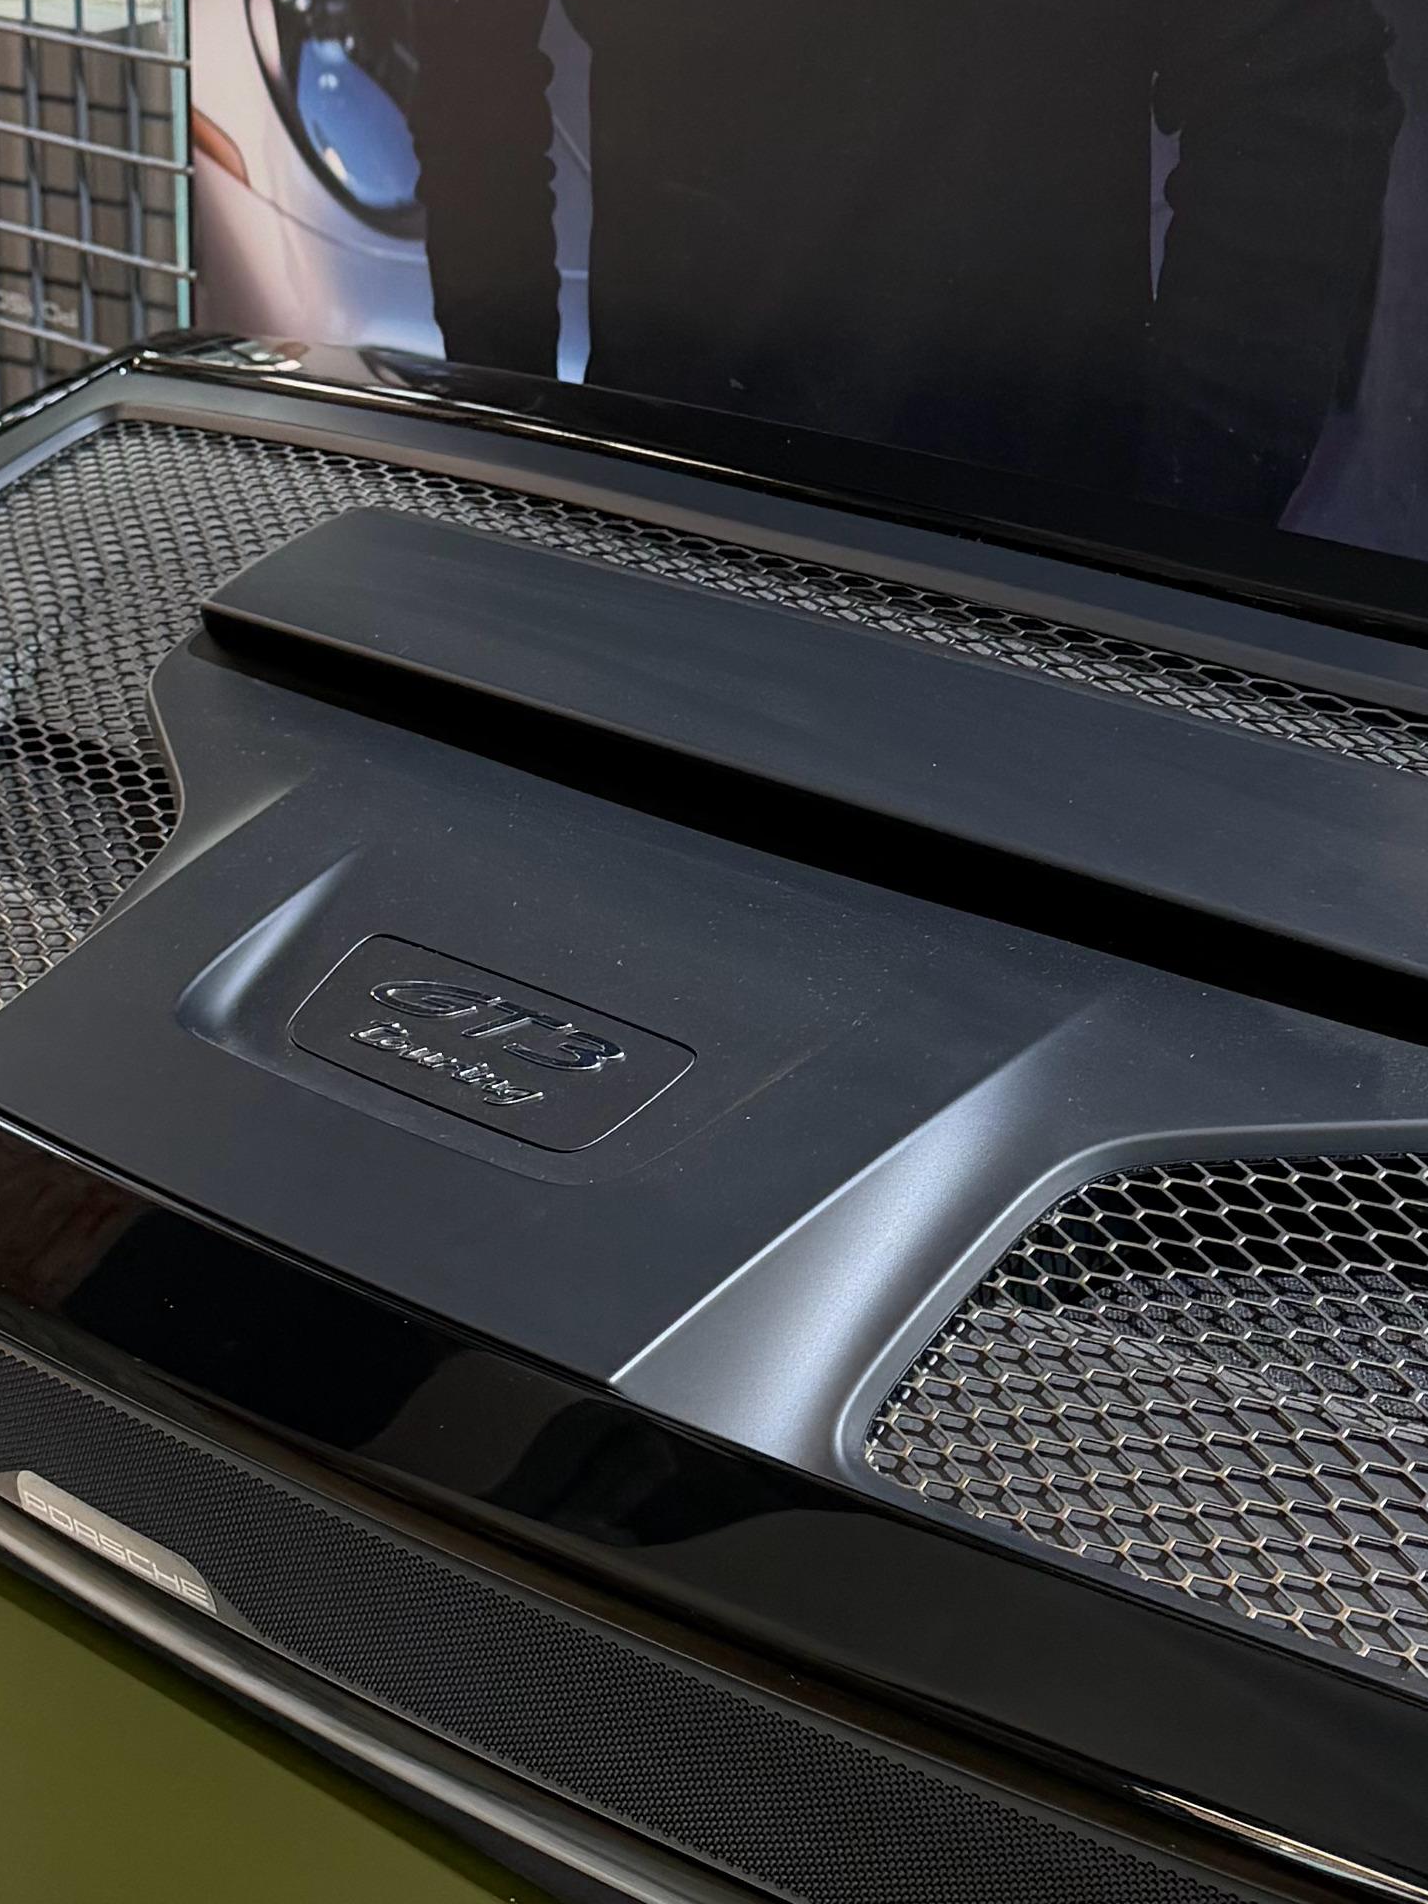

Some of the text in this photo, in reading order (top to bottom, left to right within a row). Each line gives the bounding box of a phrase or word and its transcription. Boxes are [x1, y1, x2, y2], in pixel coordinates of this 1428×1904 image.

[348, 1018, 545, 1107] Touring
[369, 979, 627, 1072] GT3
[22, 1490, 212, 1607] PORSCHE
